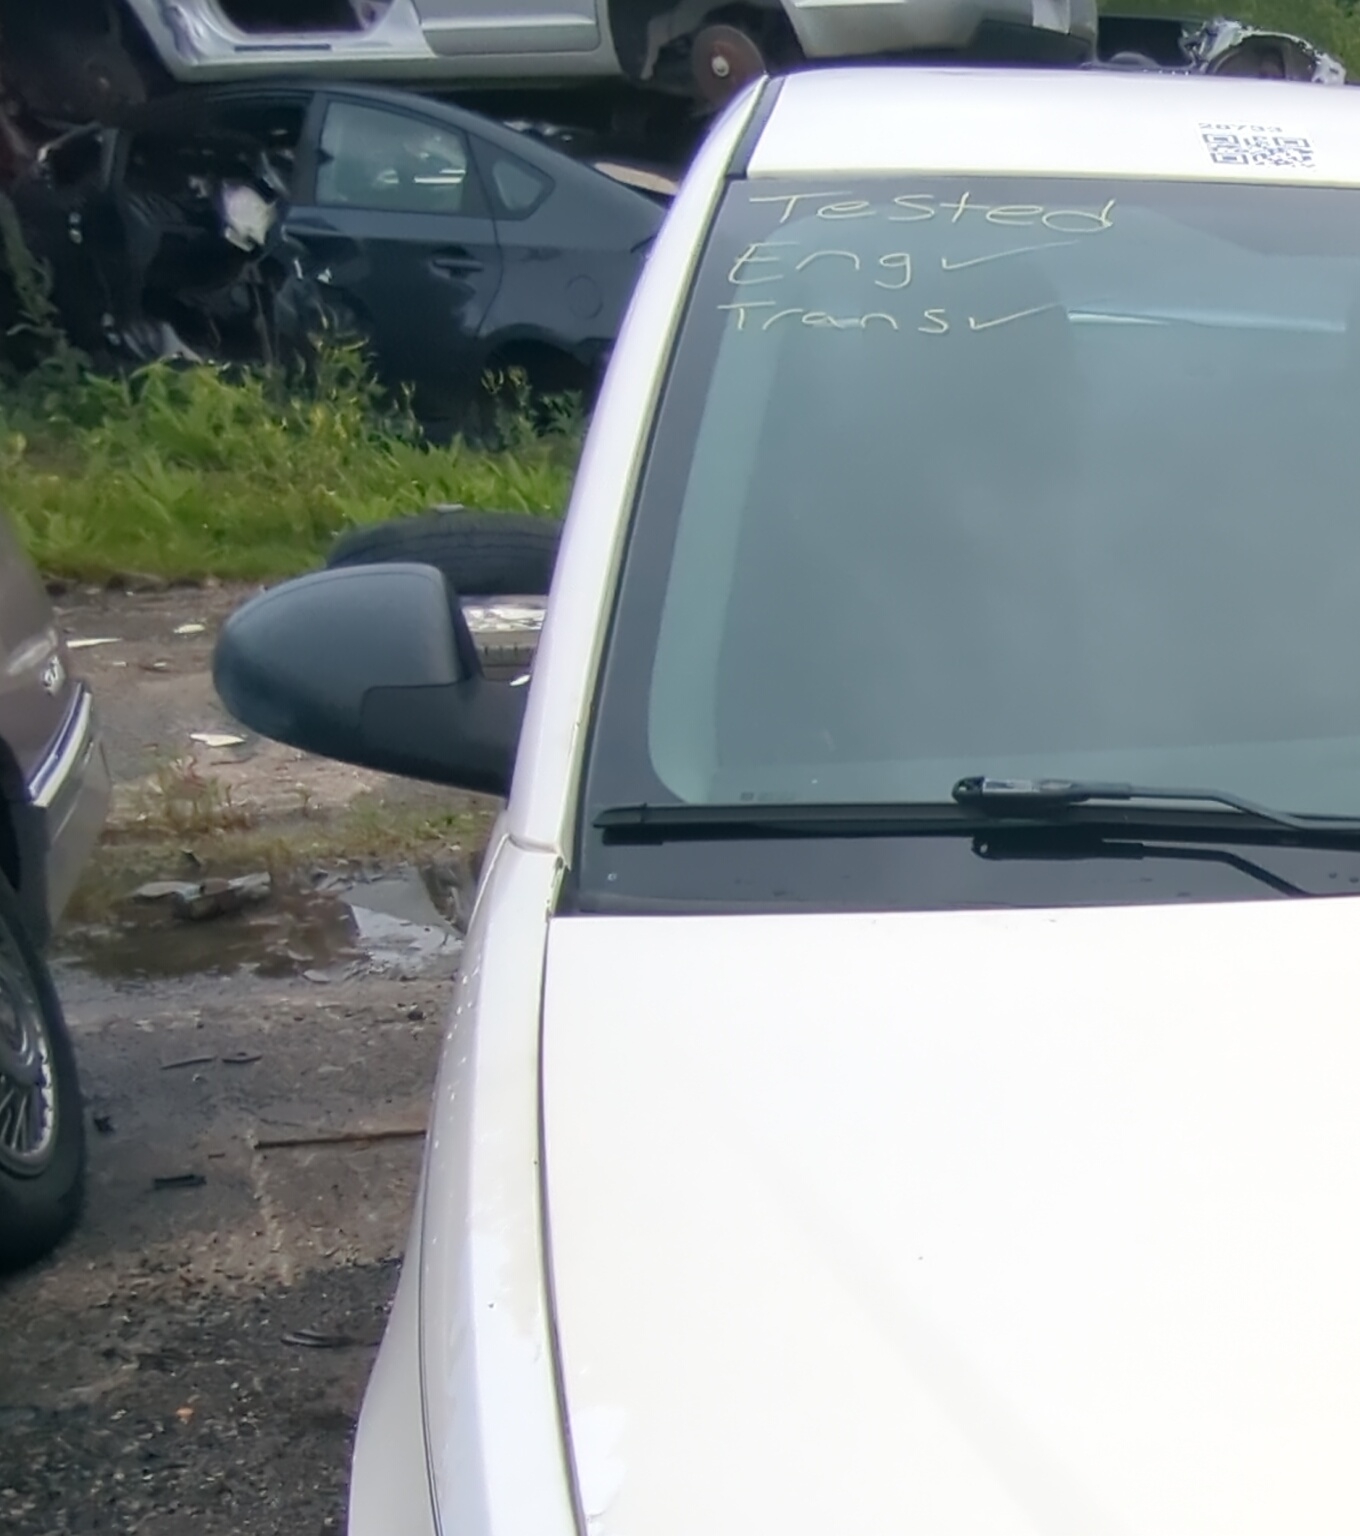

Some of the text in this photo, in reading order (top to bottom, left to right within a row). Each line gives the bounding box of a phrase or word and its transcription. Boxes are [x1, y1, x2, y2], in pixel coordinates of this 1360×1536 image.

[749, 191, 1115, 233] Tested
[728, 241, 911, 289] Eng
[717, 301, 949, 334] Trans
